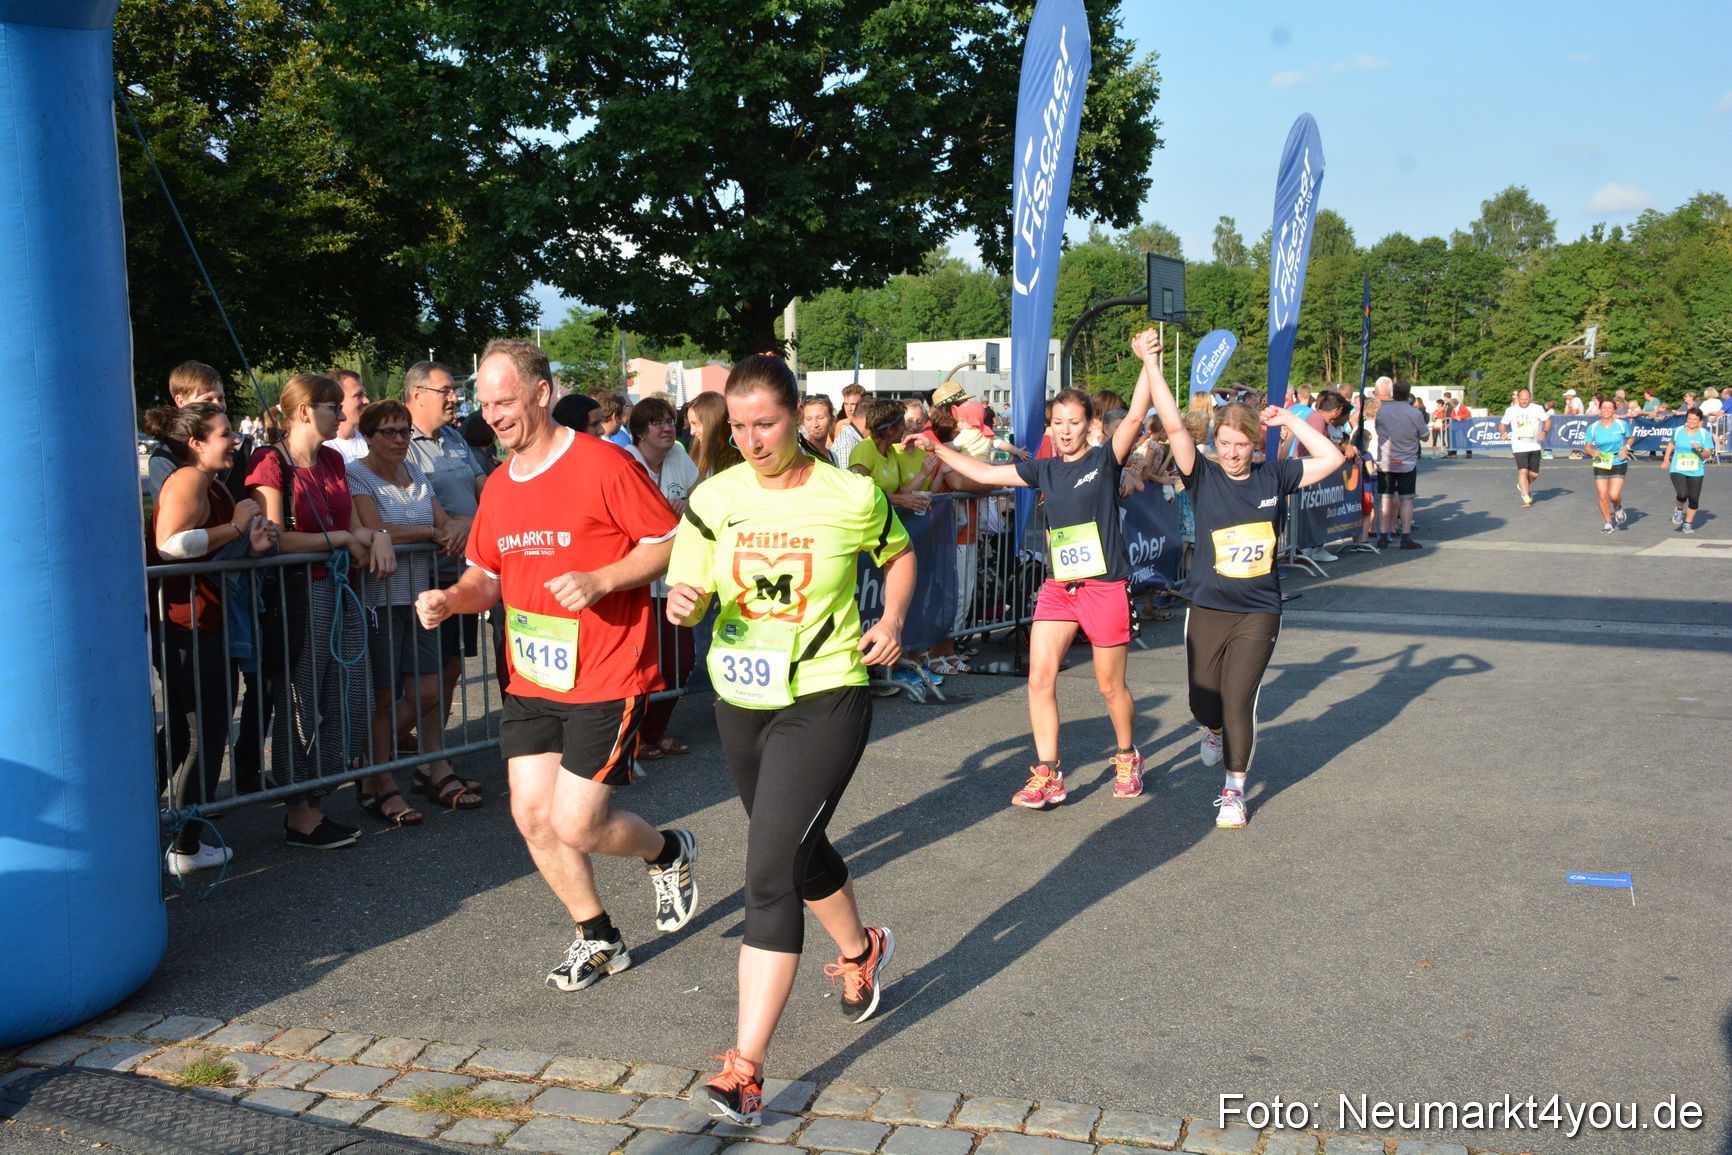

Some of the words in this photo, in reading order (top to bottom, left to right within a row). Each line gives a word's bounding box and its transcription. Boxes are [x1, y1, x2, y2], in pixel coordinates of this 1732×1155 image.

[1021, 24, 1069, 260] Fischer
[1280, 147, 1311, 306] Fischer
[1202, 337, 1227, 378] Fischer
[1680, 458, 1695, 467] 419
[735, 532, 815, 549] Müller
[1060, 546, 1092, 566] 685
[1128, 532, 1166, 566] cher
[1229, 545, 1265, 563] 725
[752, 574, 794, 605] M
[515, 637, 569, 671] 1418
[722, 655, 771, 687] 339
